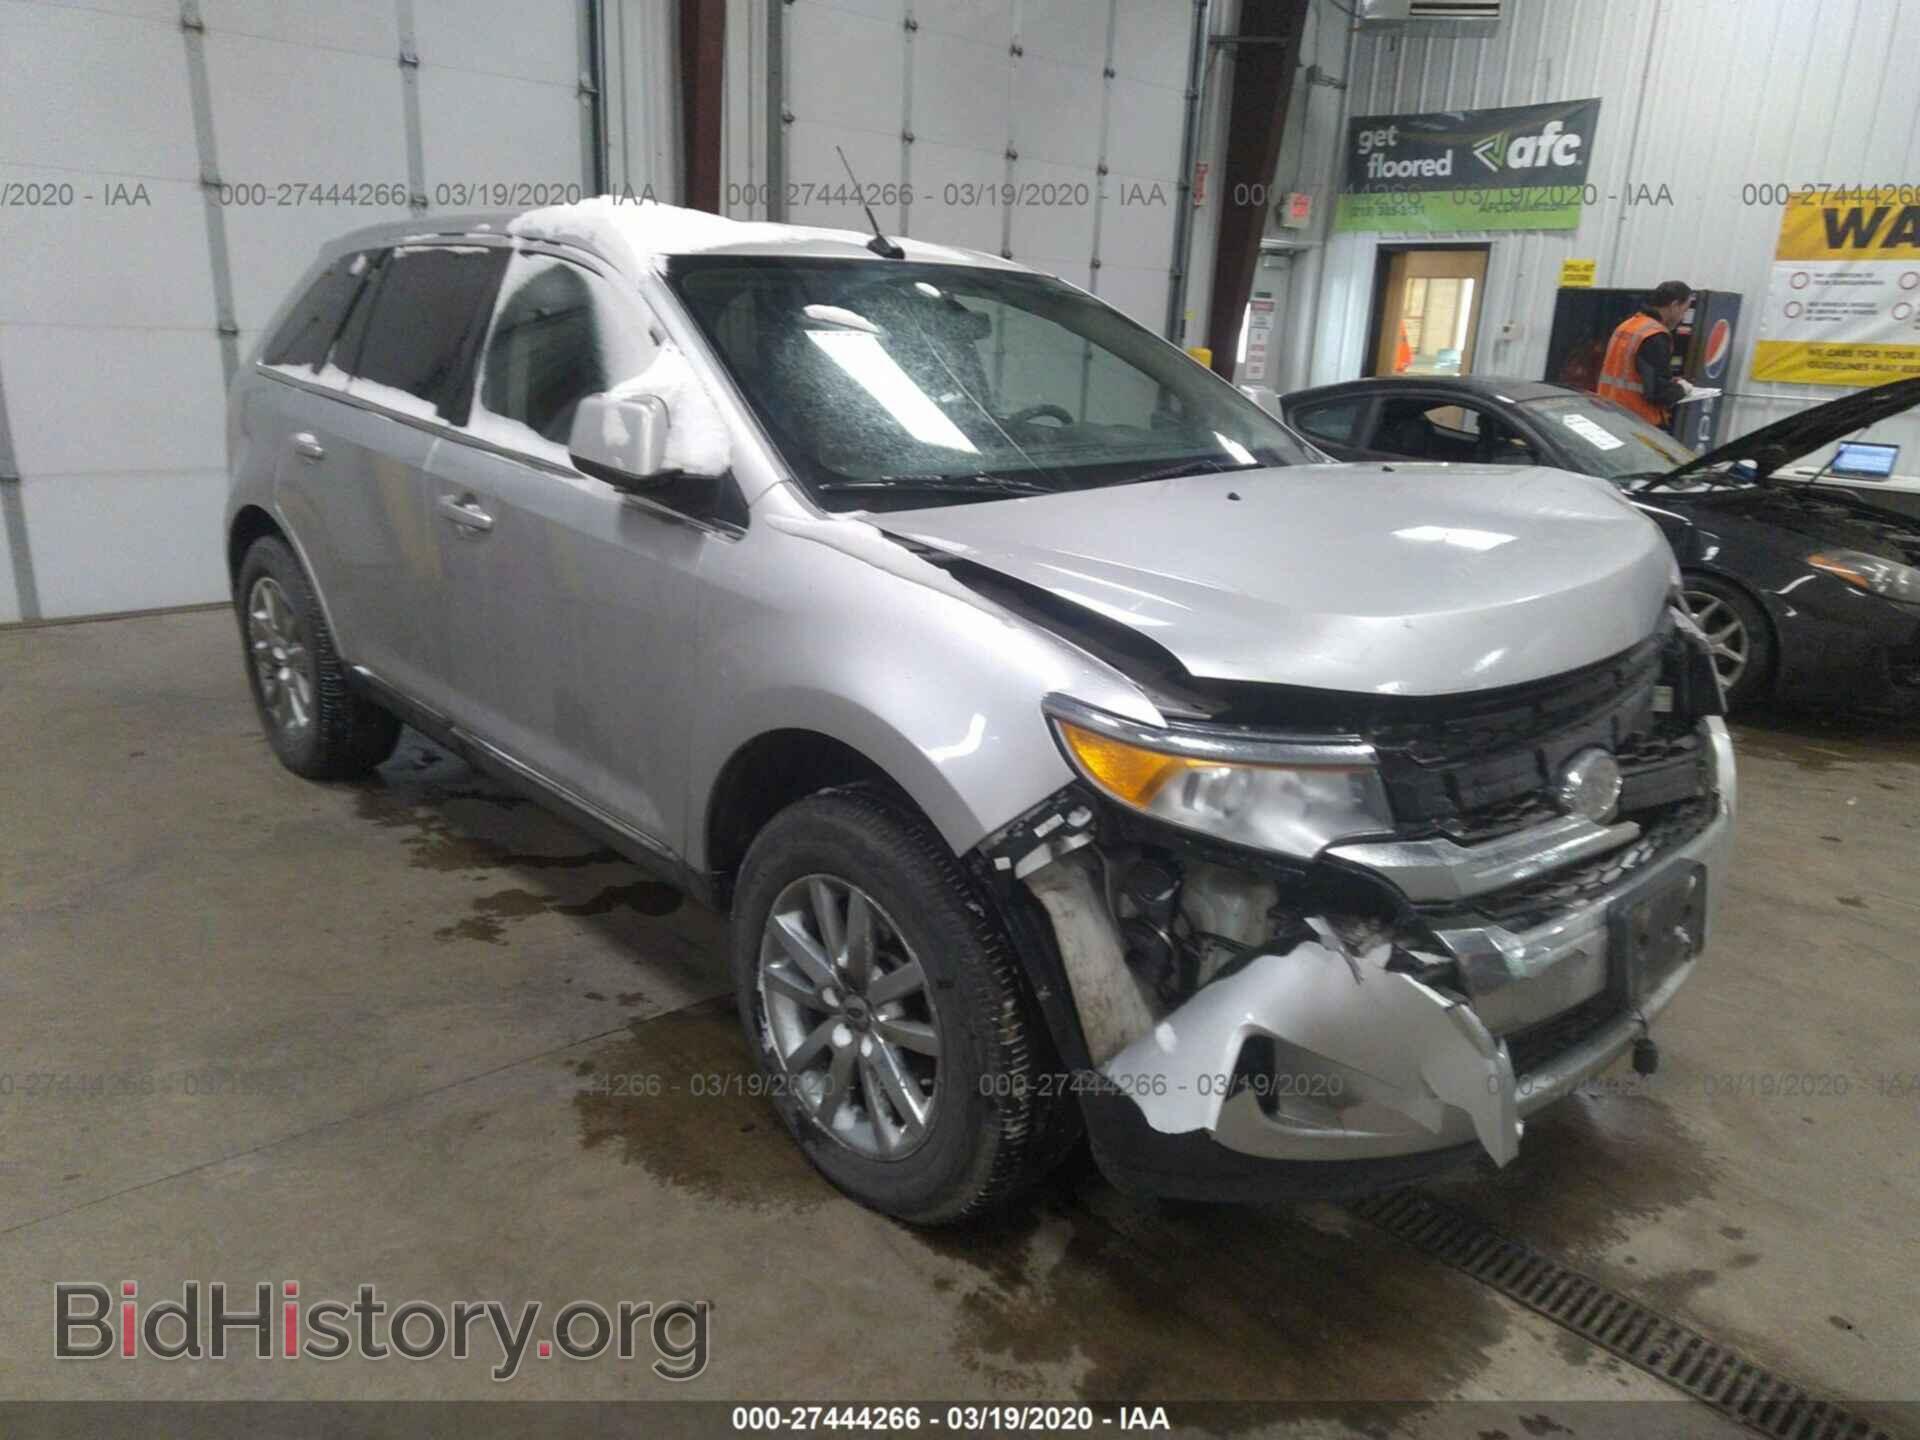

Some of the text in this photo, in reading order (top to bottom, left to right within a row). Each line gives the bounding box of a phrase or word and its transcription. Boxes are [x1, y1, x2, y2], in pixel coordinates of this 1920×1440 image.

[1359, 125, 1398, 154] get
[1506, 120, 1582, 169] afc
[1367, 149, 1453, 178] floored
